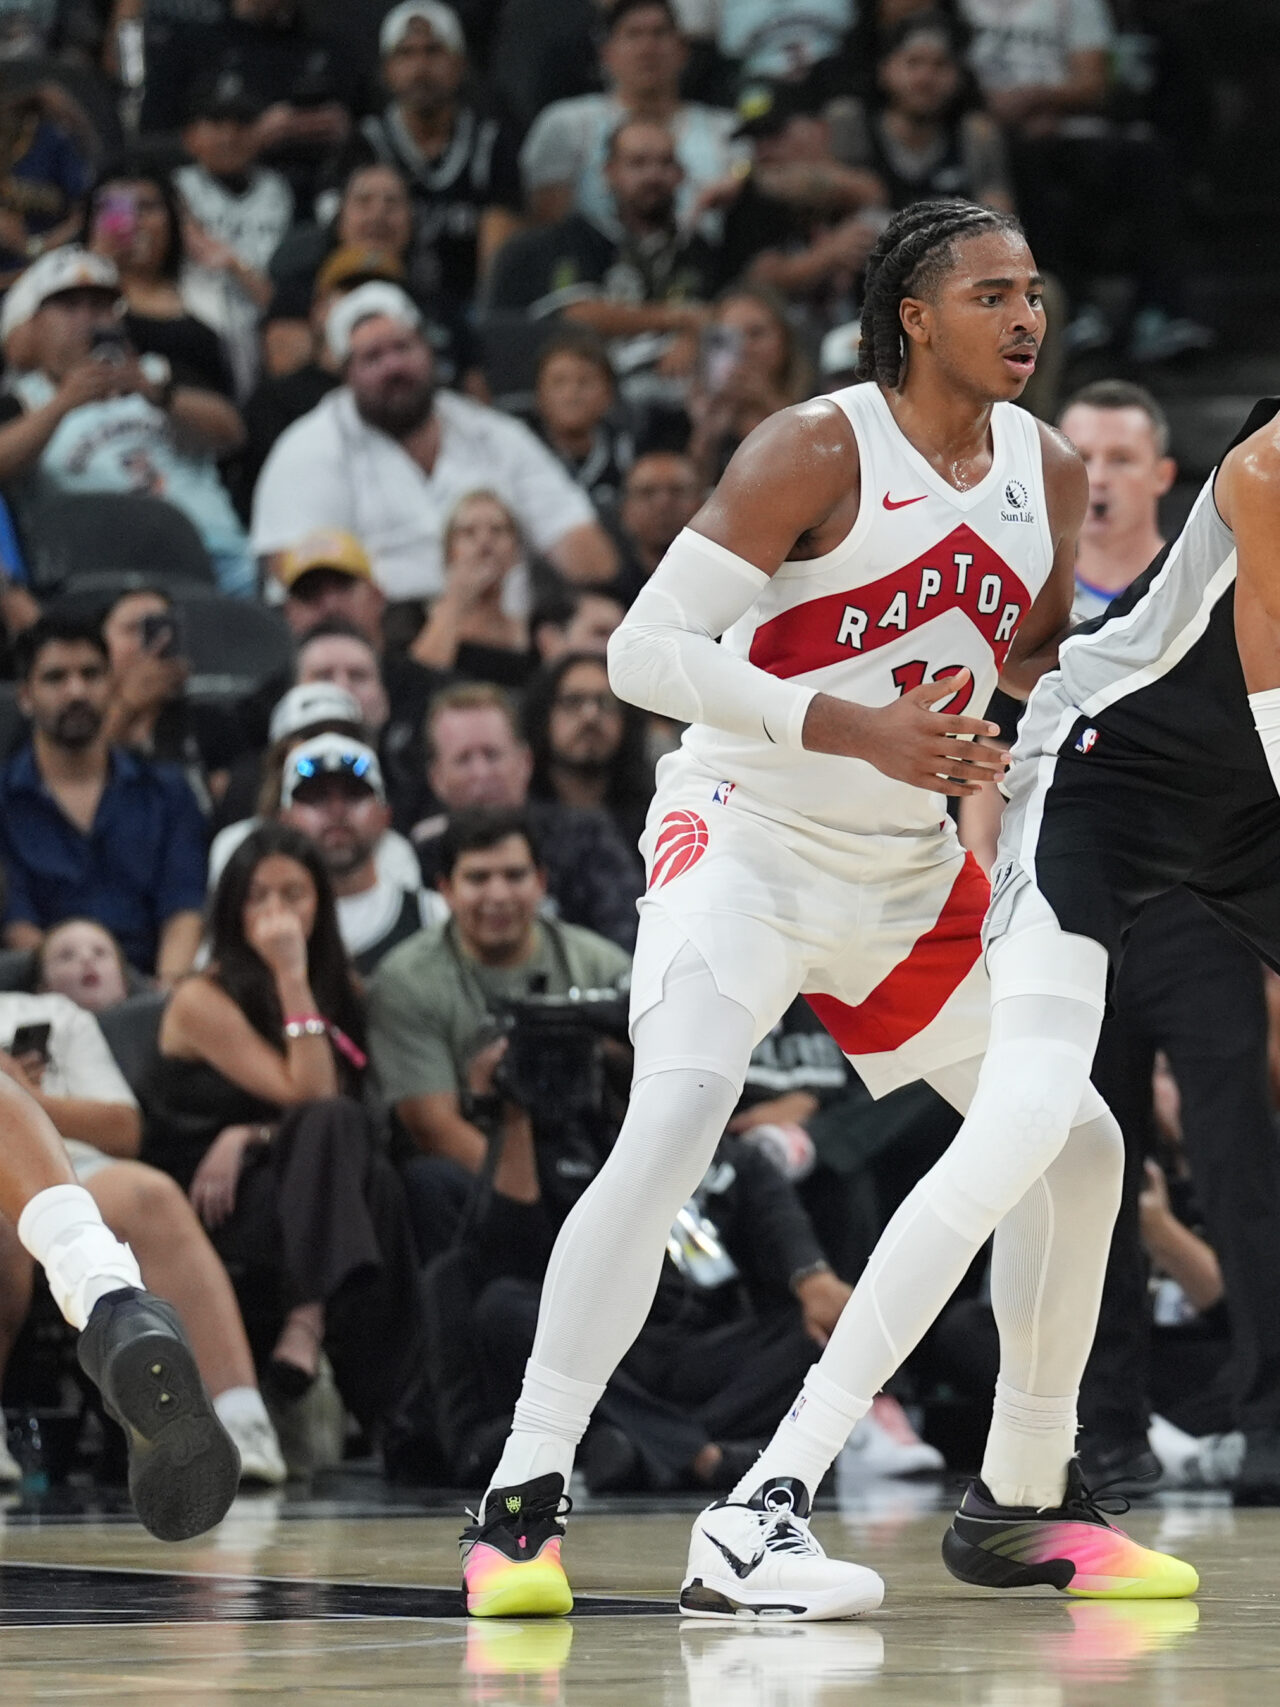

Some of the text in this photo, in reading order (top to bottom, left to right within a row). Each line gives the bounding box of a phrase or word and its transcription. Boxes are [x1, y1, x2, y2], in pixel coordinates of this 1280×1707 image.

[1000, 510, 1034, 524] Sun Life
[836, 553, 1021, 650] RAPTOR
